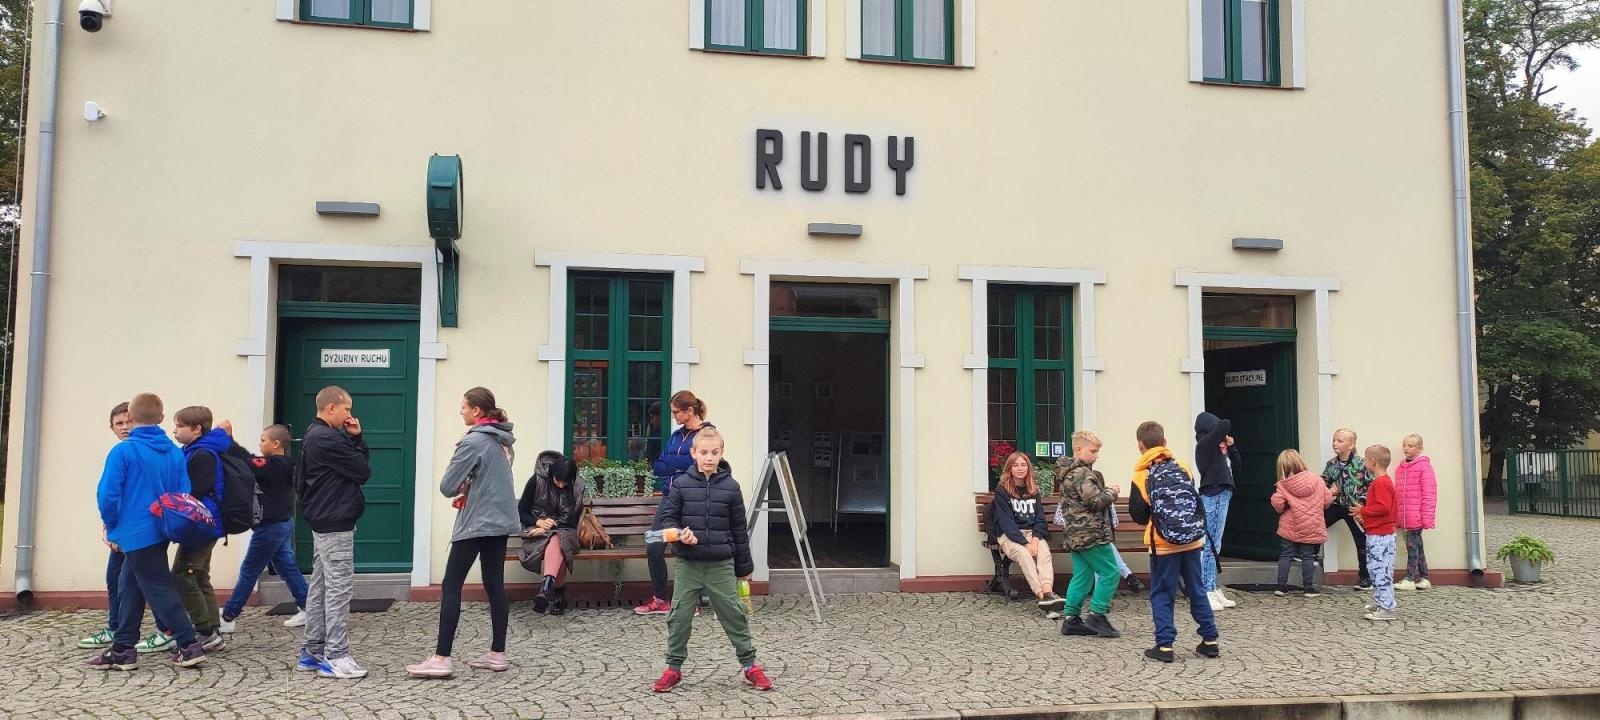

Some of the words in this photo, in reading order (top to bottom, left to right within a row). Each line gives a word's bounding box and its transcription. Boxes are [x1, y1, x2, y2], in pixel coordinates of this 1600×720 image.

[756, 128, 915, 196] RUDY
[324, 353, 359, 363] DYŻURNY
[361, 354, 387, 363] RUCHU
